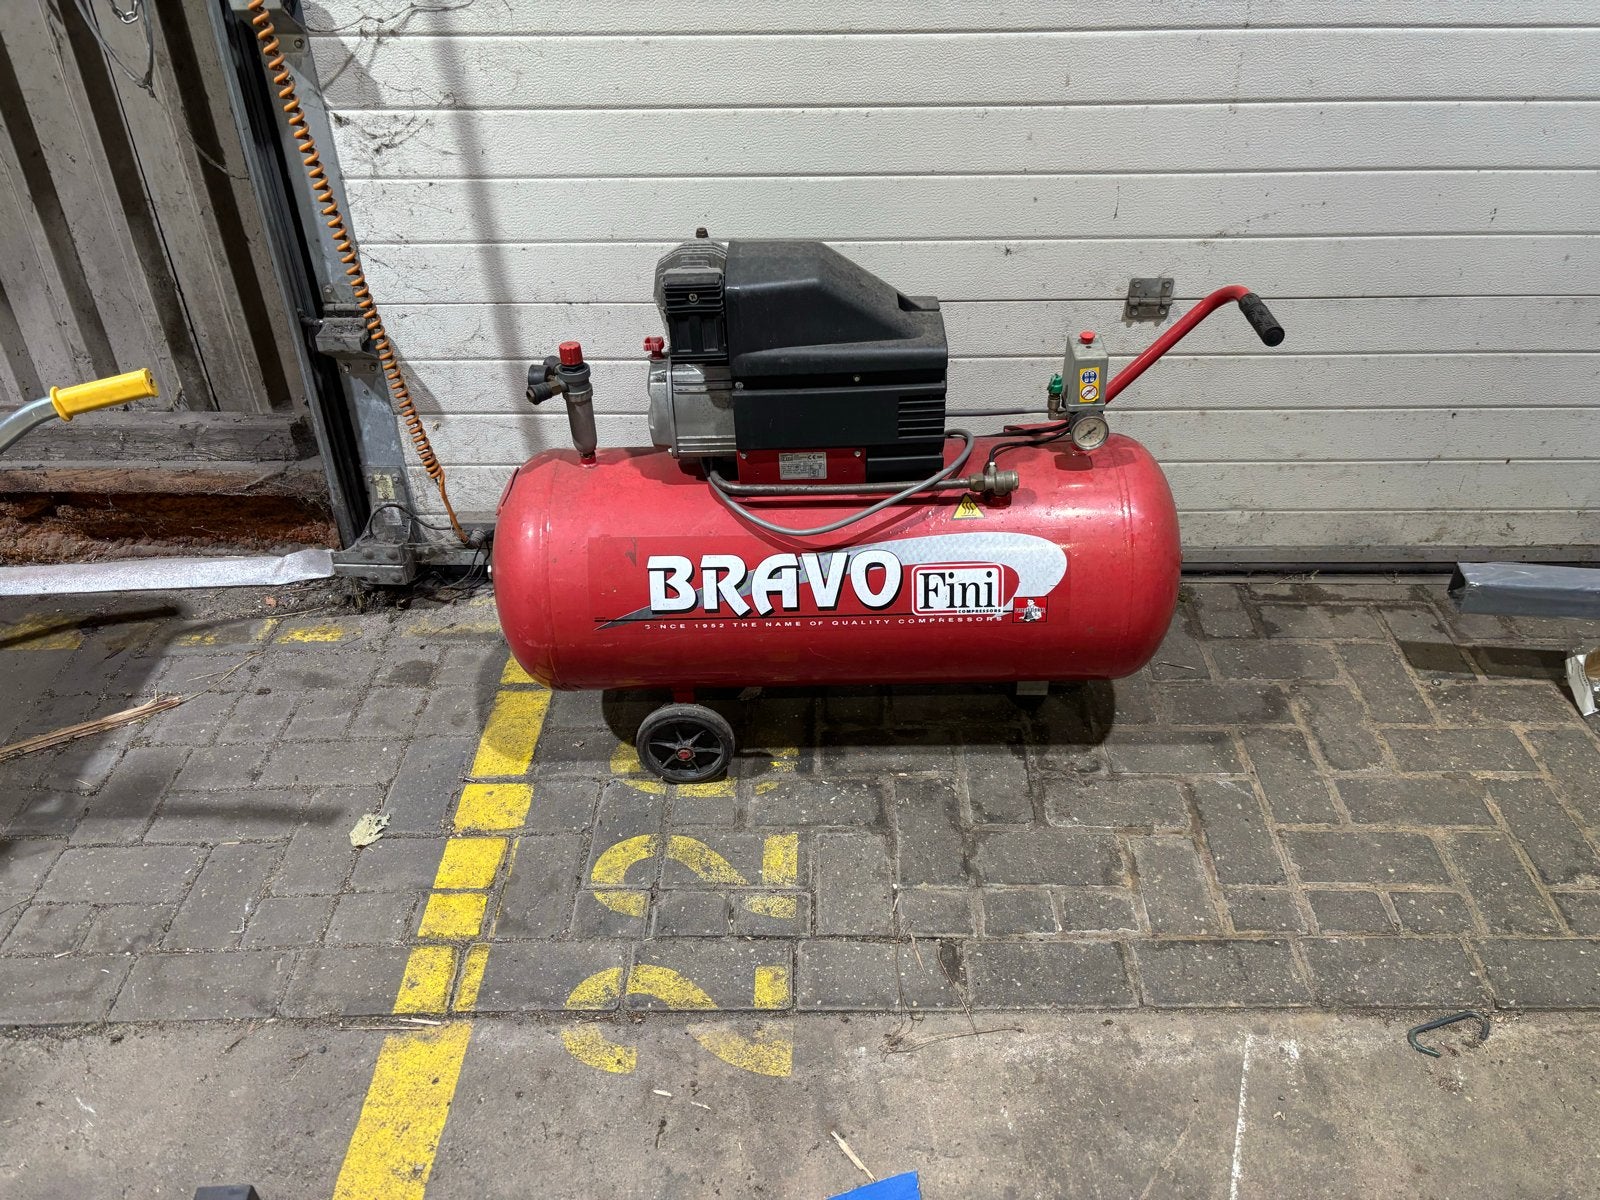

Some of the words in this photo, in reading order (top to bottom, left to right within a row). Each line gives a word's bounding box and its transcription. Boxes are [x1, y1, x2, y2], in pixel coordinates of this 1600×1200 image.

[646, 550, 903, 617] BRAVO
[919, 570, 996, 609] Fini
[898, 616, 1003, 624] COMPRESSORS
